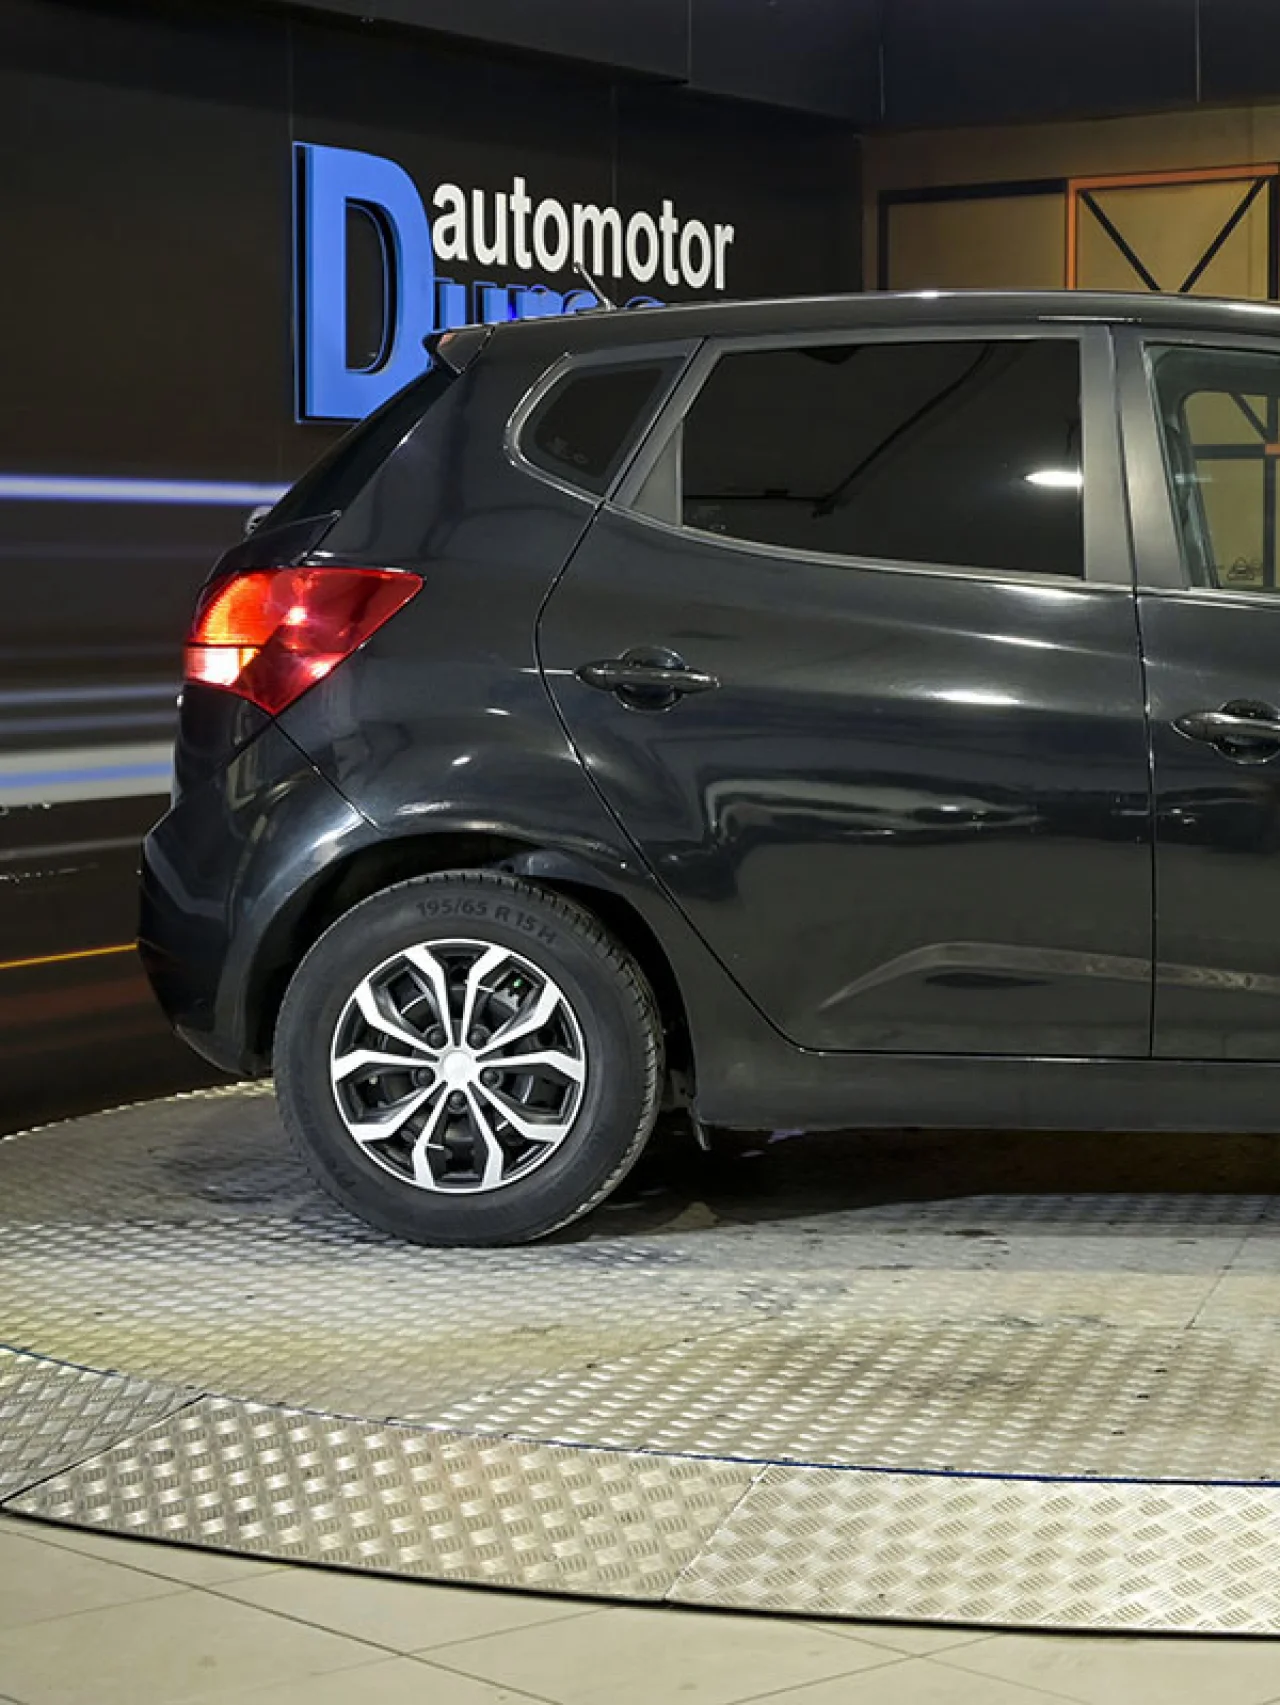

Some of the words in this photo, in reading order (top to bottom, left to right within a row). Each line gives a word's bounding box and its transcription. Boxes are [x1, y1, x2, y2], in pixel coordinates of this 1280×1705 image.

[432, 176, 735, 290] automotor
[415, 897, 488, 918] 195/65
[495, 904, 511, 922] R
[516, 911, 537, 932] 15
